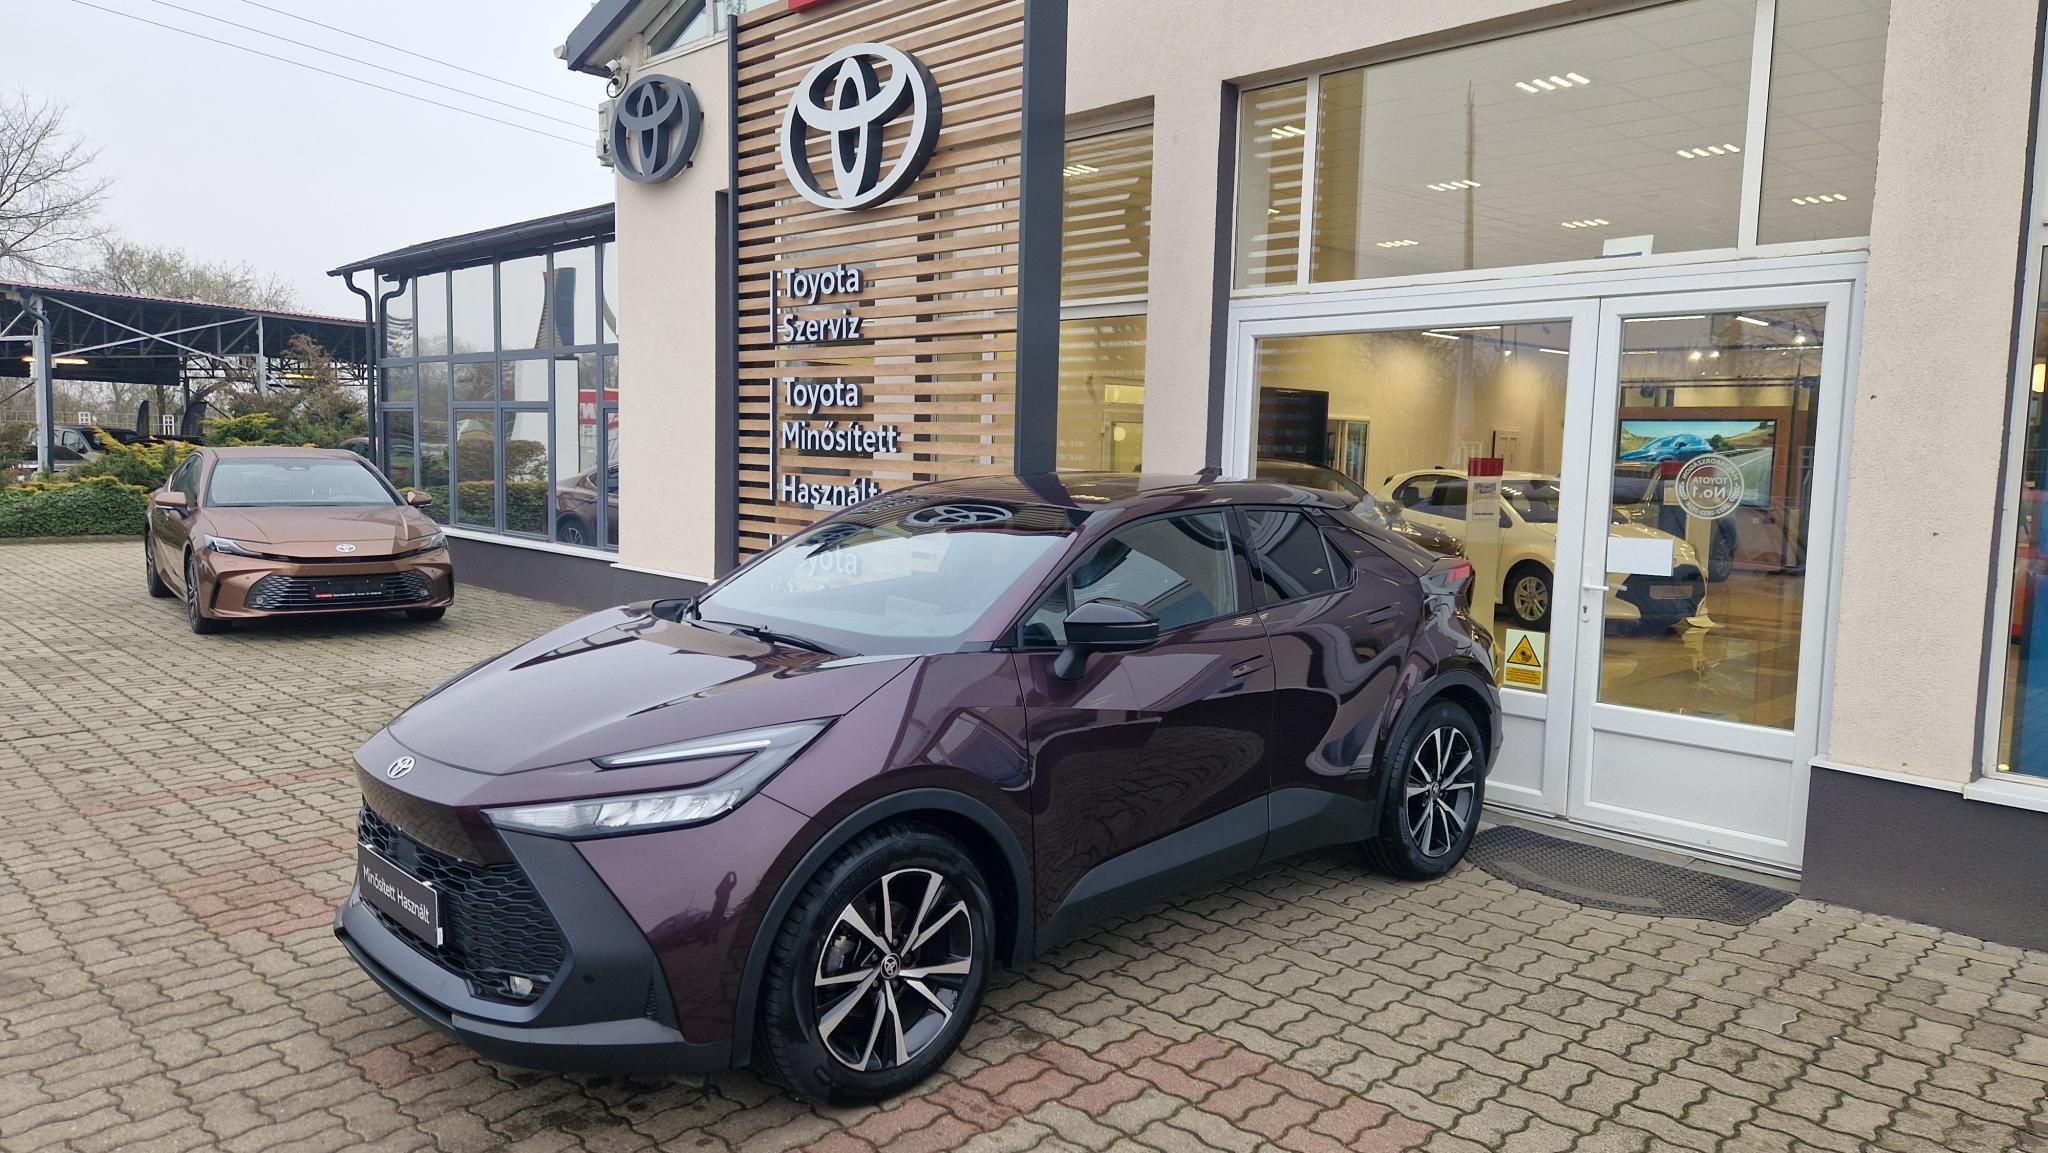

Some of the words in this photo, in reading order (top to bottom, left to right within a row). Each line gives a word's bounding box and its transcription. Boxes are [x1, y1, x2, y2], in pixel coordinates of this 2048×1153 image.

[782, 264, 863, 304] Toyota
[782, 308, 863, 342] Szerviz
[782, 376, 862, 415] Toyota
[781, 421, 901, 453] Minősített
[781, 474, 880, 507] Használt
[362, 864, 396, 903] Minősített
[396, 889, 430, 924] Használt
